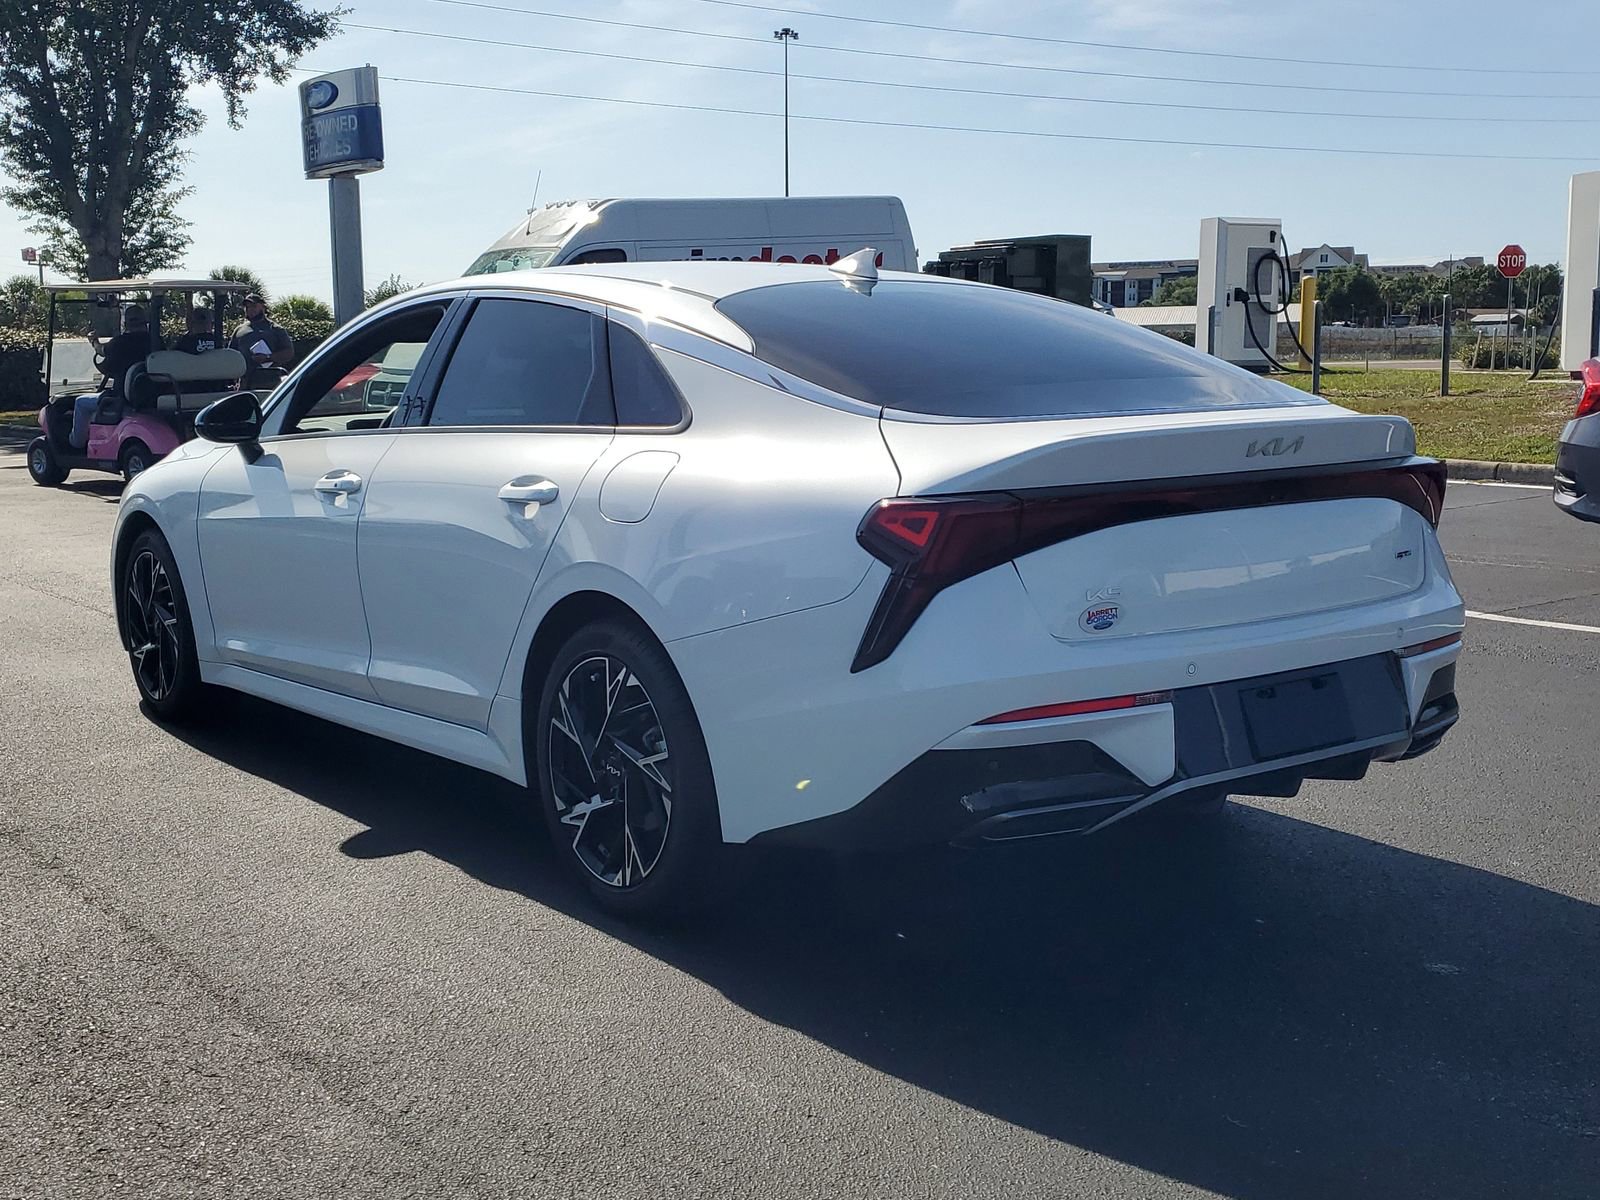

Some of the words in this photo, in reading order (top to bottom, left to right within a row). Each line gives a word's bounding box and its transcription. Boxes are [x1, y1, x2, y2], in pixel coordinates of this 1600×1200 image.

[304, 114, 358, 141] RE-OWNED
[305, 140, 352, 162] EHICES
[1500, 254, 1525, 268] STOP
[1245, 435, 1305, 458] KIA
